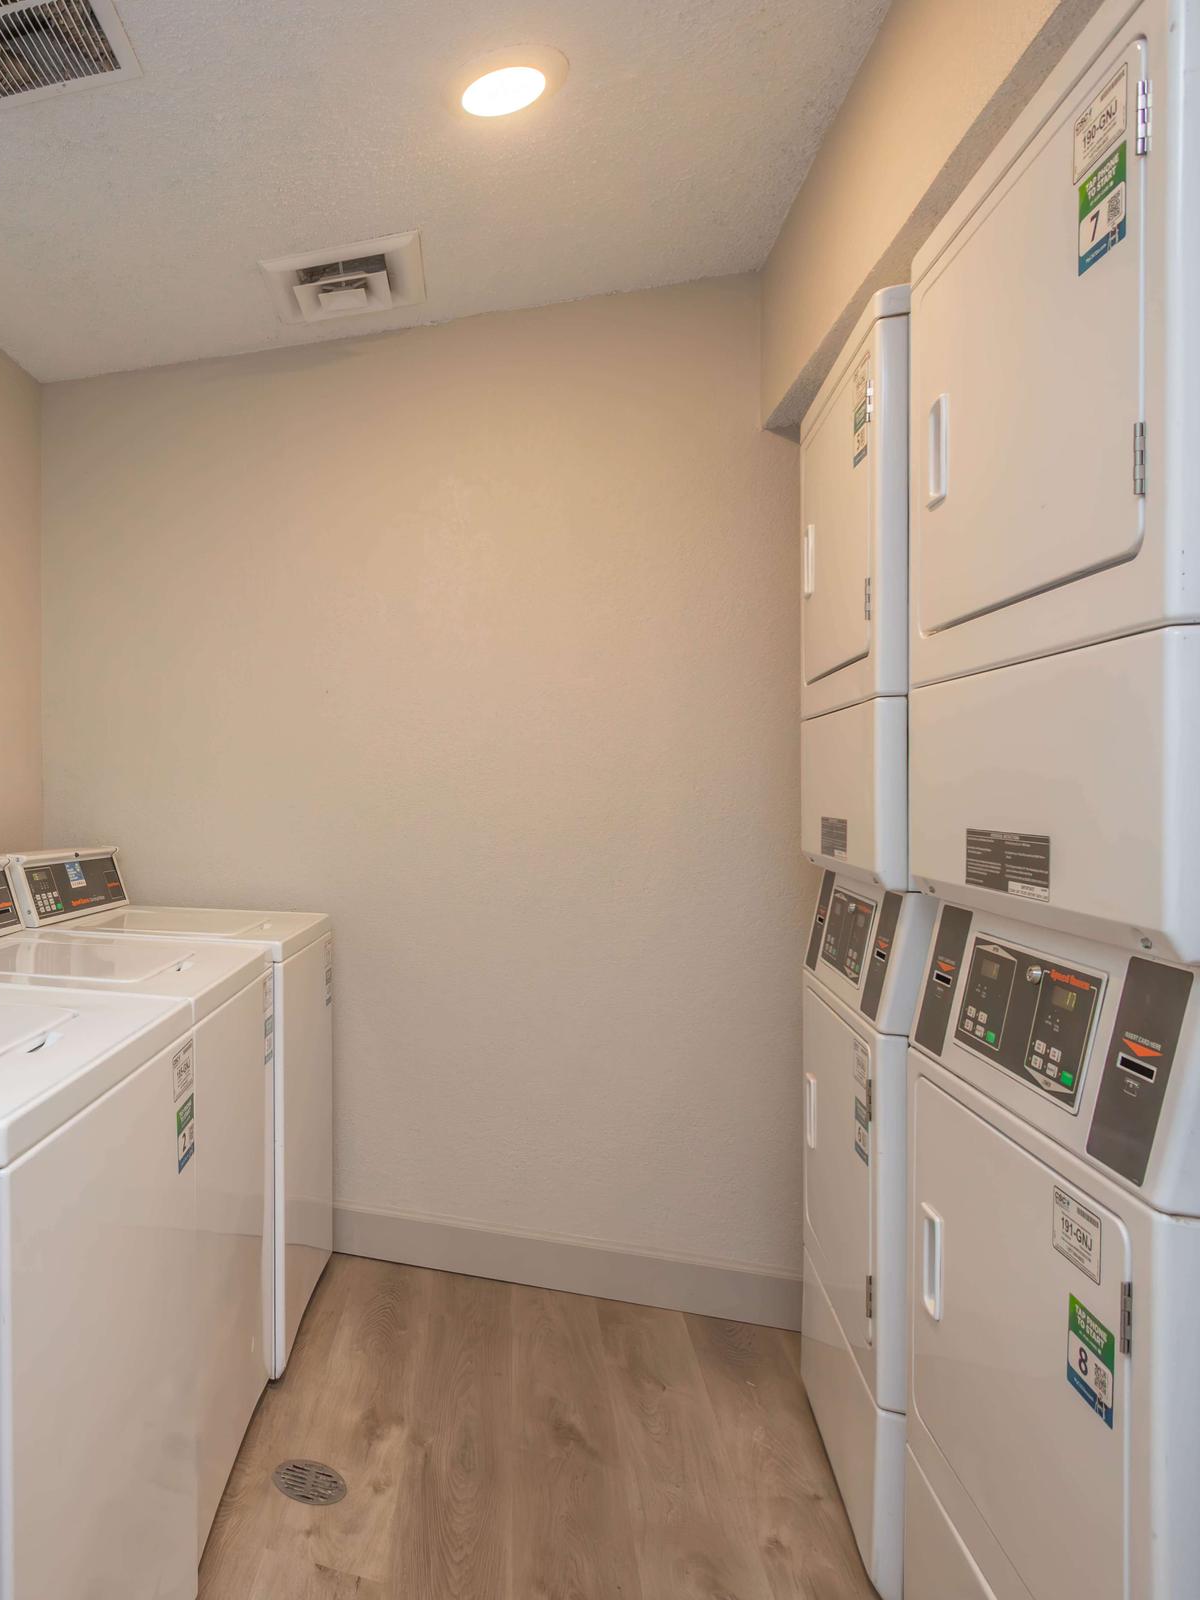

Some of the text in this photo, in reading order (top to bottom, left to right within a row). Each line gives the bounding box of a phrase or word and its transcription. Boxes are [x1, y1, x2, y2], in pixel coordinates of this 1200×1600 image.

[1083, 100, 1118, 149] 190-GNJ
[1090, 209, 1100, 243] 7
[1061, 1216, 1093, 1252] 191-GNJ
[1078, 1346, 1088, 1376] 8
